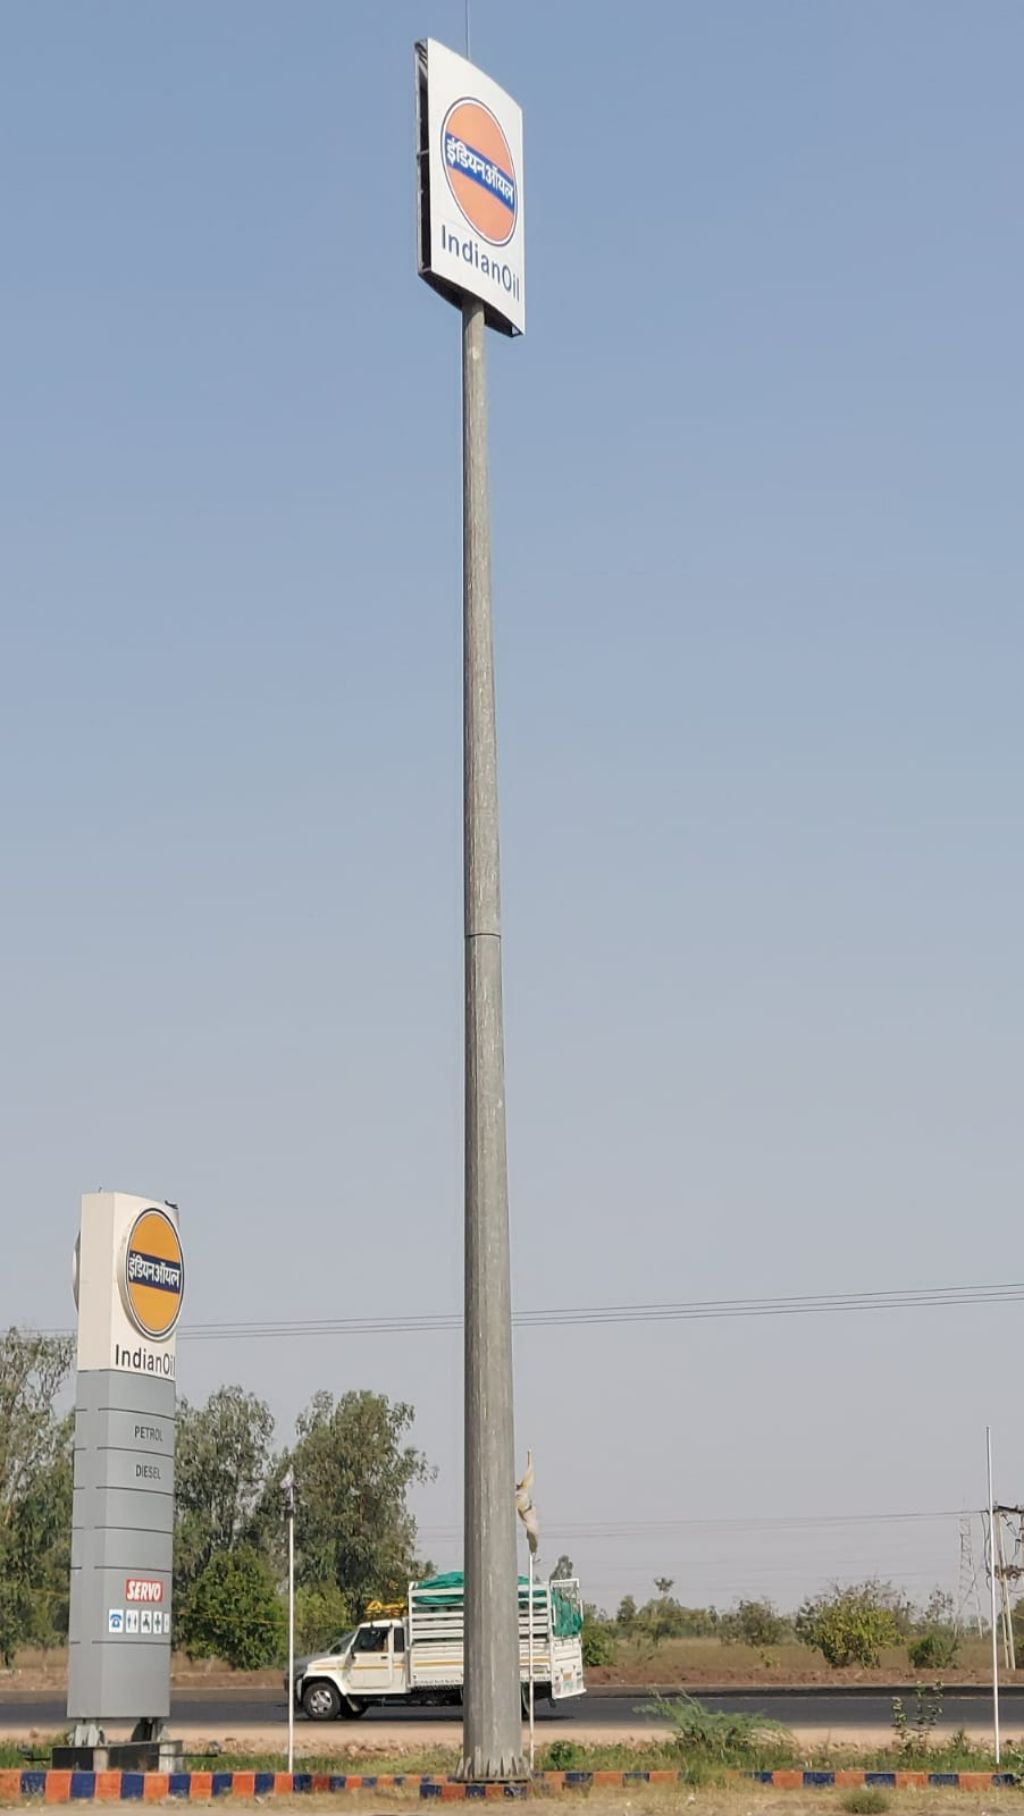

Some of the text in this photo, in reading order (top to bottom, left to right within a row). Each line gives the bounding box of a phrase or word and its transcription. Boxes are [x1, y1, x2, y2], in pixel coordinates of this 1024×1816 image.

[446, 138, 514, 203] इंडियनऑयल
[441, 225, 520, 301] IndianOil
[128, 1254, 179, 1287] इंडियनऑयल
[116, 1344, 175, 1377] IndianOil
[134, 1425, 163, 1442] PETROL
[135, 1464, 161, 1480] DIESEL
[126, 1581, 161, 1601] SERVO
